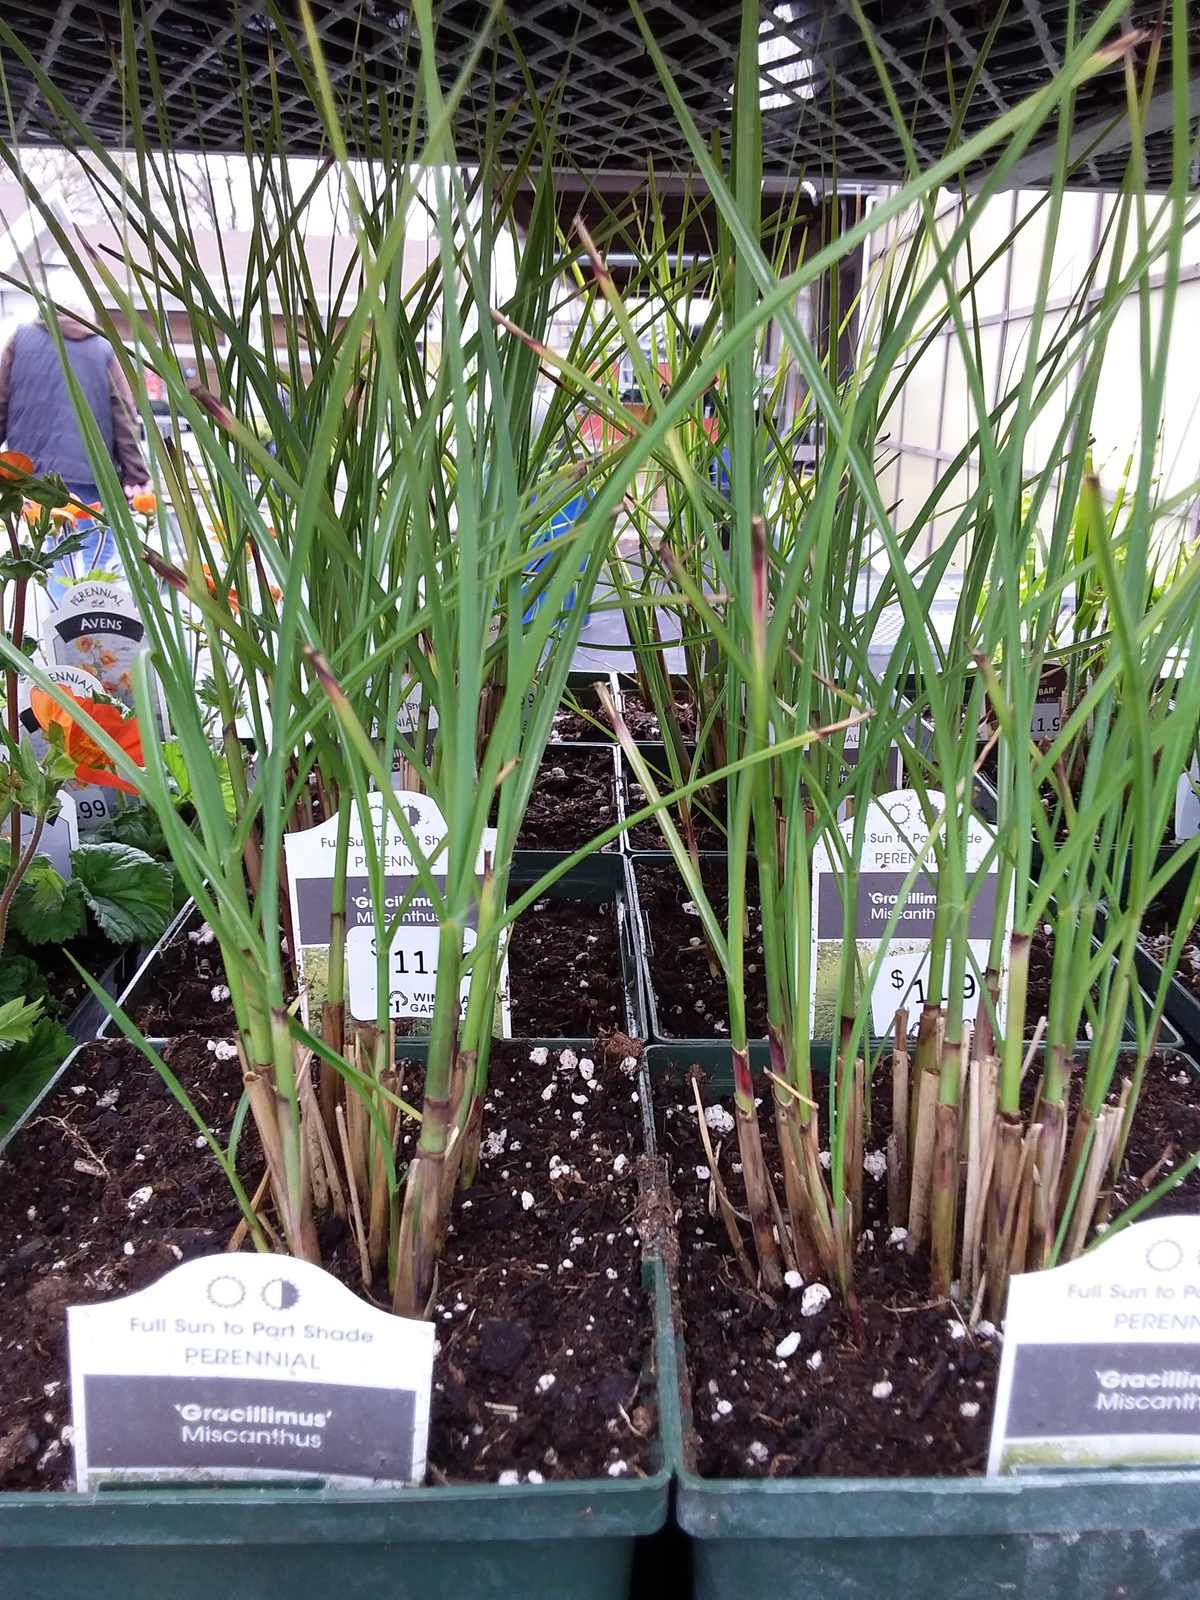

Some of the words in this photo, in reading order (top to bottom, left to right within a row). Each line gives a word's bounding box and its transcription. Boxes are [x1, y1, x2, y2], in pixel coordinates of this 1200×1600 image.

[70, 586, 124, 607] PERENNIAL
[80, 617, 123, 631] AVENS
[48, 671, 93, 693] ENNIAL
[321, 837, 337, 848] Fu
[347, 836, 364, 847] Su
[393, 835, 421, 847] Pat
[870, 832, 893, 844] Sun
[1066, 1283, 1102, 1299] Full
[1109, 1283, 1148, 1300] Sun
[1155, 1284, 1176, 1300] to
[130, 1317, 167, 1333] Full
[174, 1317, 216, 1335] Sun
[224, 1319, 245, 1336] to
[252, 1321, 296, 1339] Part
[303, 1324, 375, 1344] Shade
[1113, 1312, 1200, 1330] PERENN
[185, 1347, 321, 1371] PERENNIAL
[1095, 1391, 1200, 1411] Miscanth
[181, 1425, 323, 1449] Miscanthus
